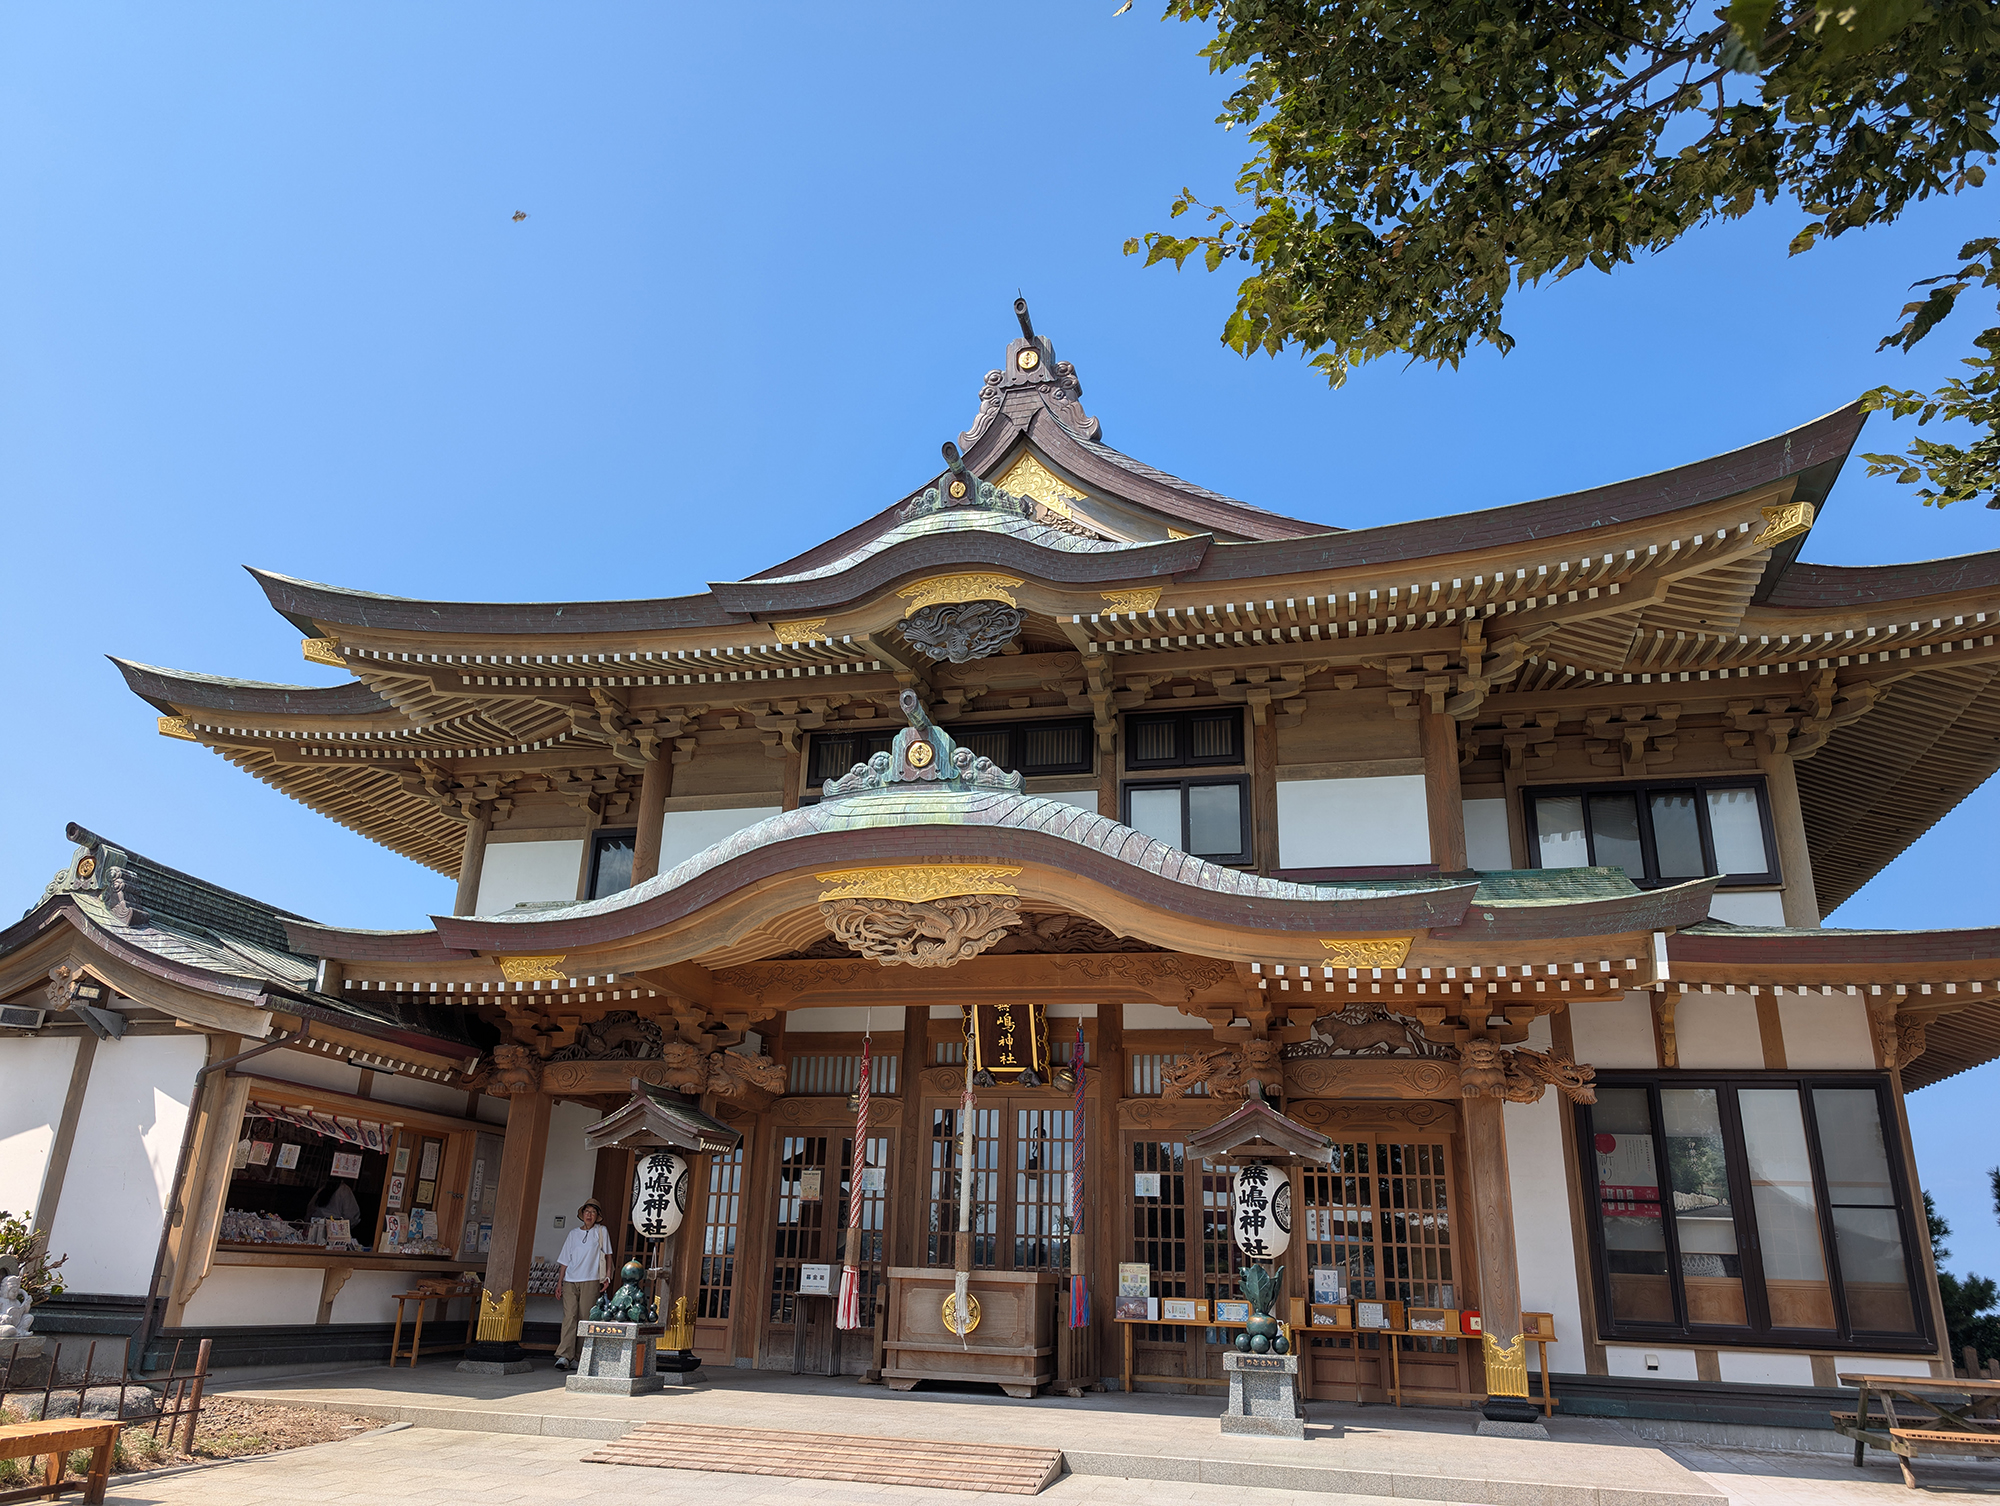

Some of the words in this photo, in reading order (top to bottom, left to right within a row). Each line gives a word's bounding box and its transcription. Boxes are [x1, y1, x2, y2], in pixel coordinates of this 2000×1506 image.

[641, 1154, 674, 1235] 蕪嶋神社
[1239, 1166, 1272, 1256] 蕪嶋神社
